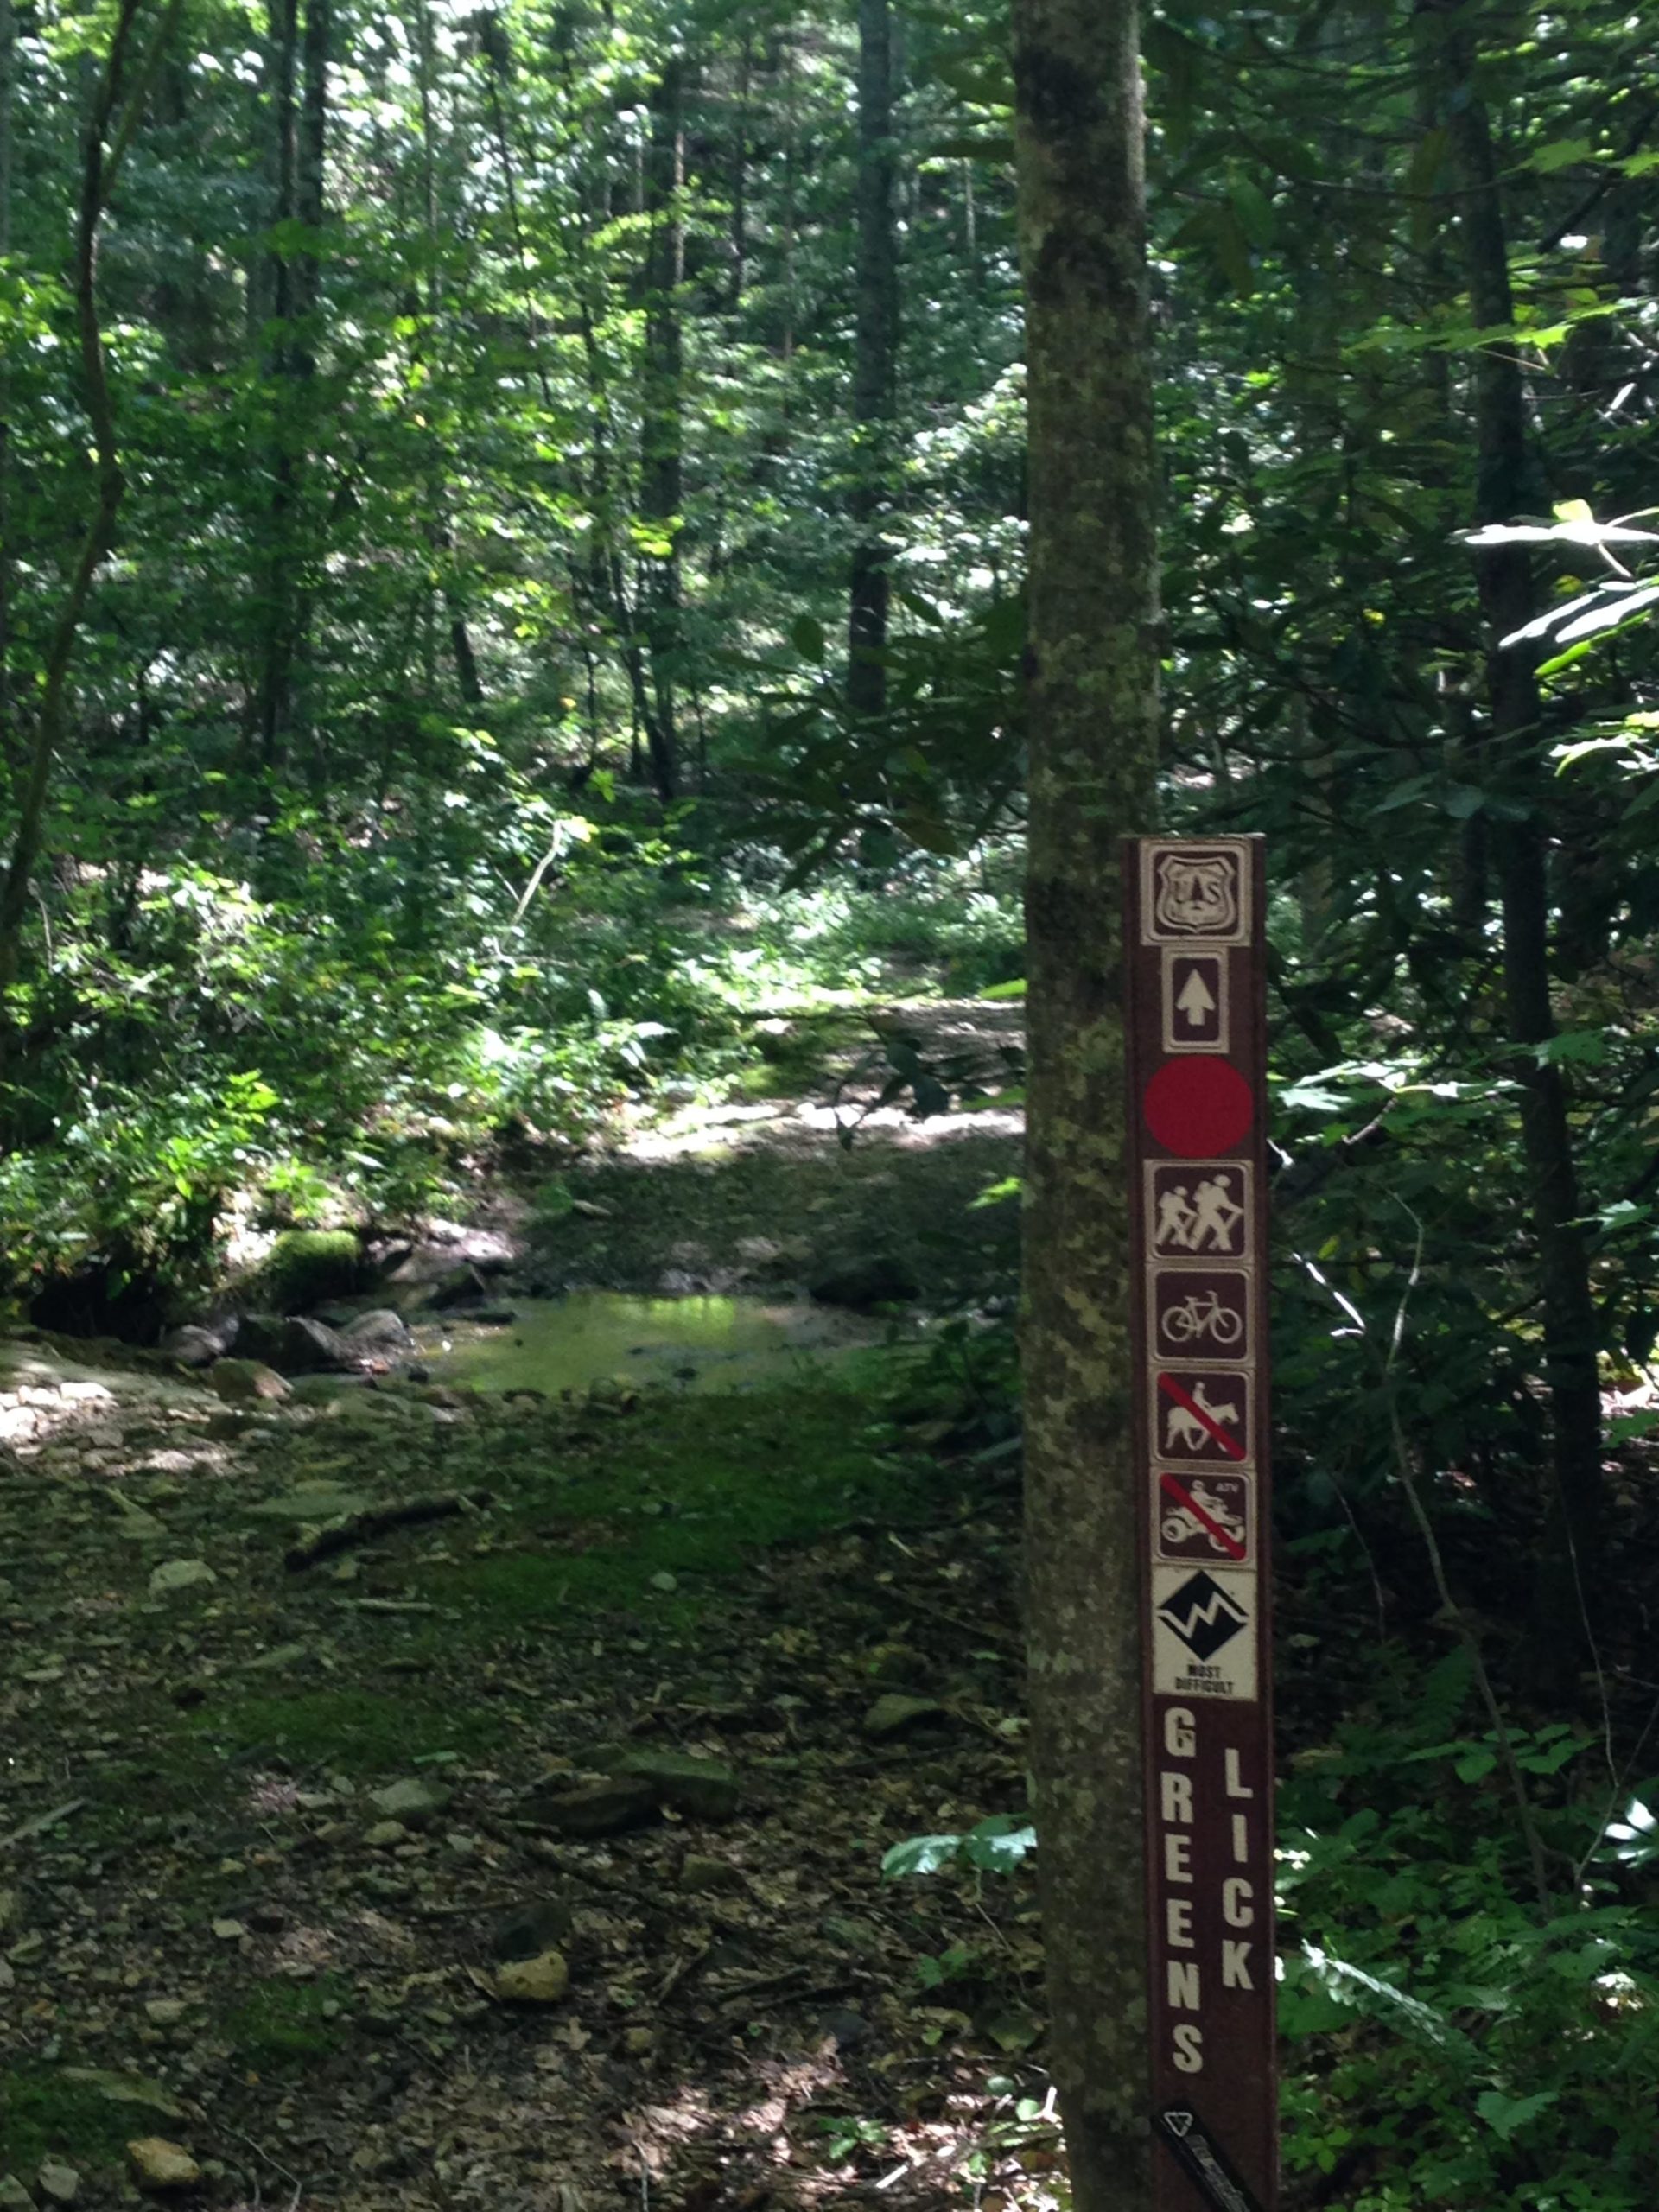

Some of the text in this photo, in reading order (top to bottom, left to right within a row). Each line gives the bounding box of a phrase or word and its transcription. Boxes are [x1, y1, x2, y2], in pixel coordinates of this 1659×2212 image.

[1216, 1482, 1239, 1493] ATV
[1187, 1663, 1221, 1678] MOST
[1174, 1676, 1234, 1694] DIFFICULT
[1222, 1748, 1255, 1991] LICK
[1160, 1707, 1204, 2074] GREENS
